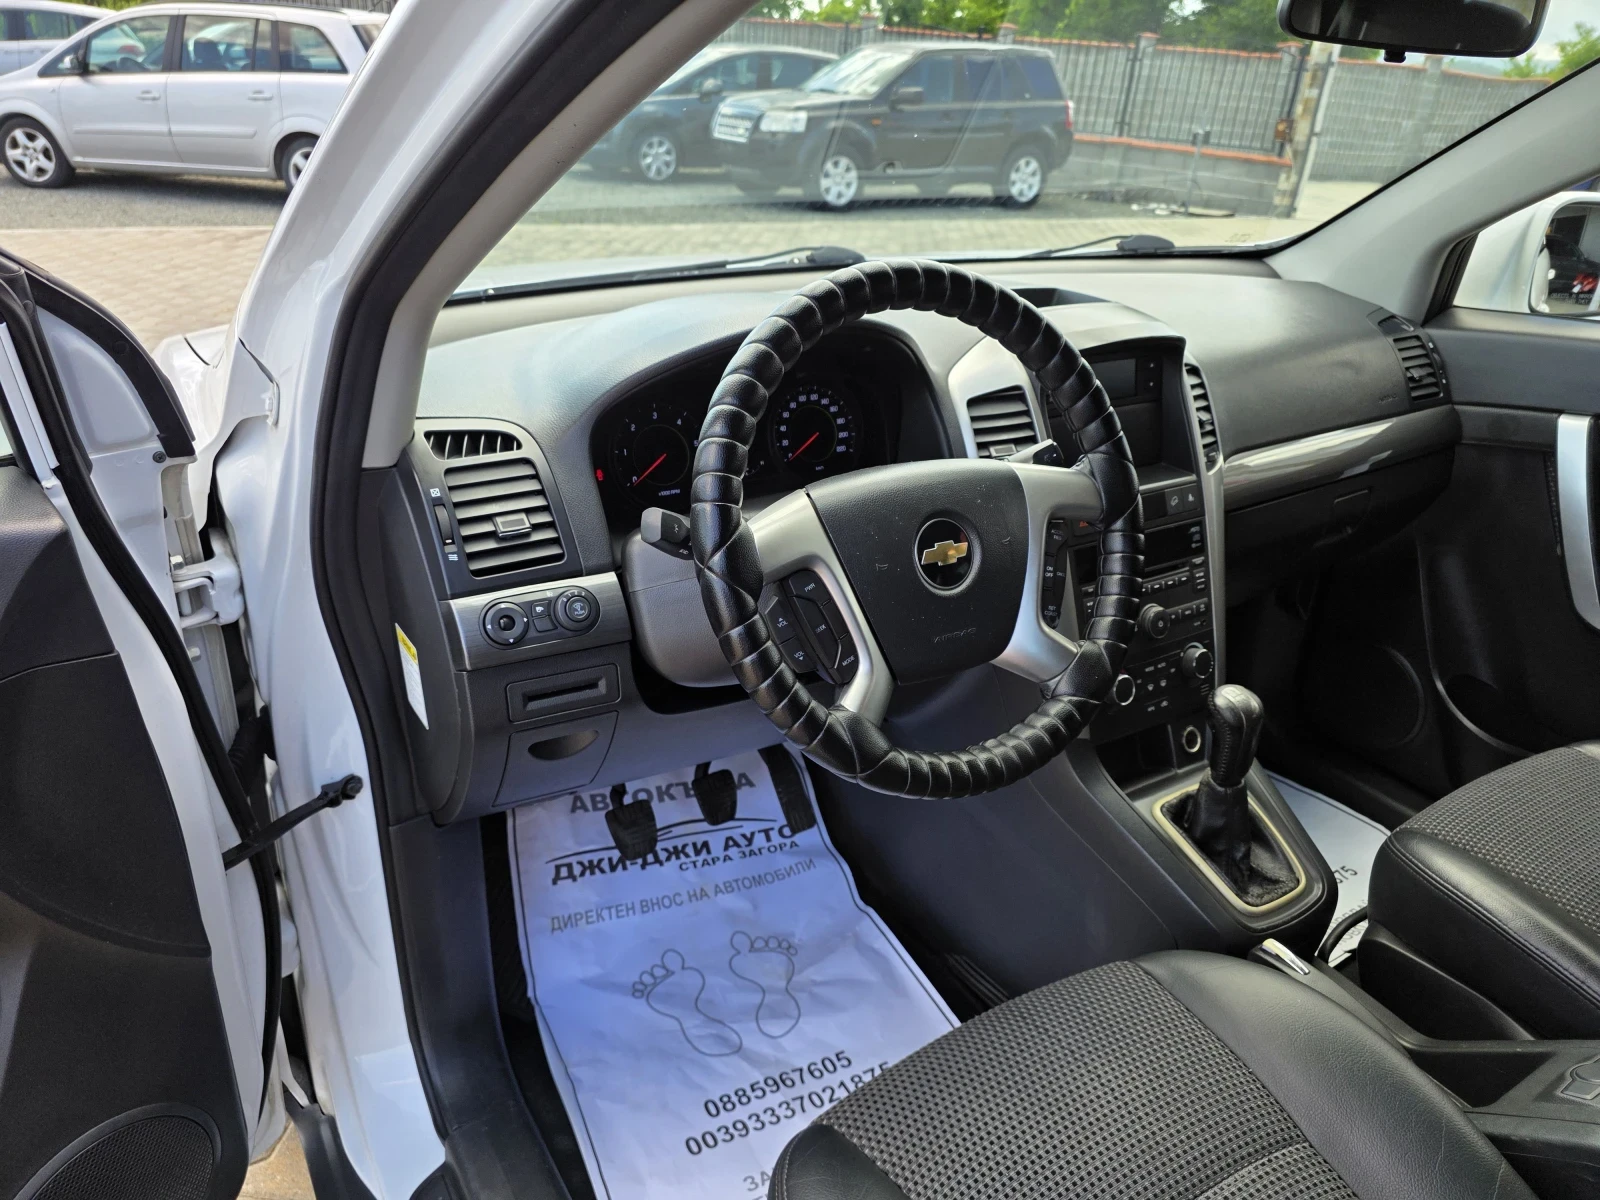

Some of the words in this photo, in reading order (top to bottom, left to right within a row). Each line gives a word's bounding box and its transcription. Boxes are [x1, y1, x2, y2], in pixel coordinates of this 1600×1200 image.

[652, 411, 658, 419] 3
[776, 620, 789, 628] VOL
[793, 650, 805, 658] VOL
[841, 654, 856, 666] MODE
[570, 772, 756, 814] АВОКЪА
[551, 840, 712, 886] ДЖИ-ДЖИ
[723, 824, 796, 851] АУТО
[679, 854, 733, 872] СТАРА
[738, 841, 800, 860] ЗАГОРА
[551, 901, 636, 934] ДИРЕКТЕН
[640, 892, 684, 915] ВНОС
[687, 887, 711, 904] НА
[714, 858, 818, 899] АВТОМОБИЛИ
[703, 1050, 852, 1118] 0885967605
